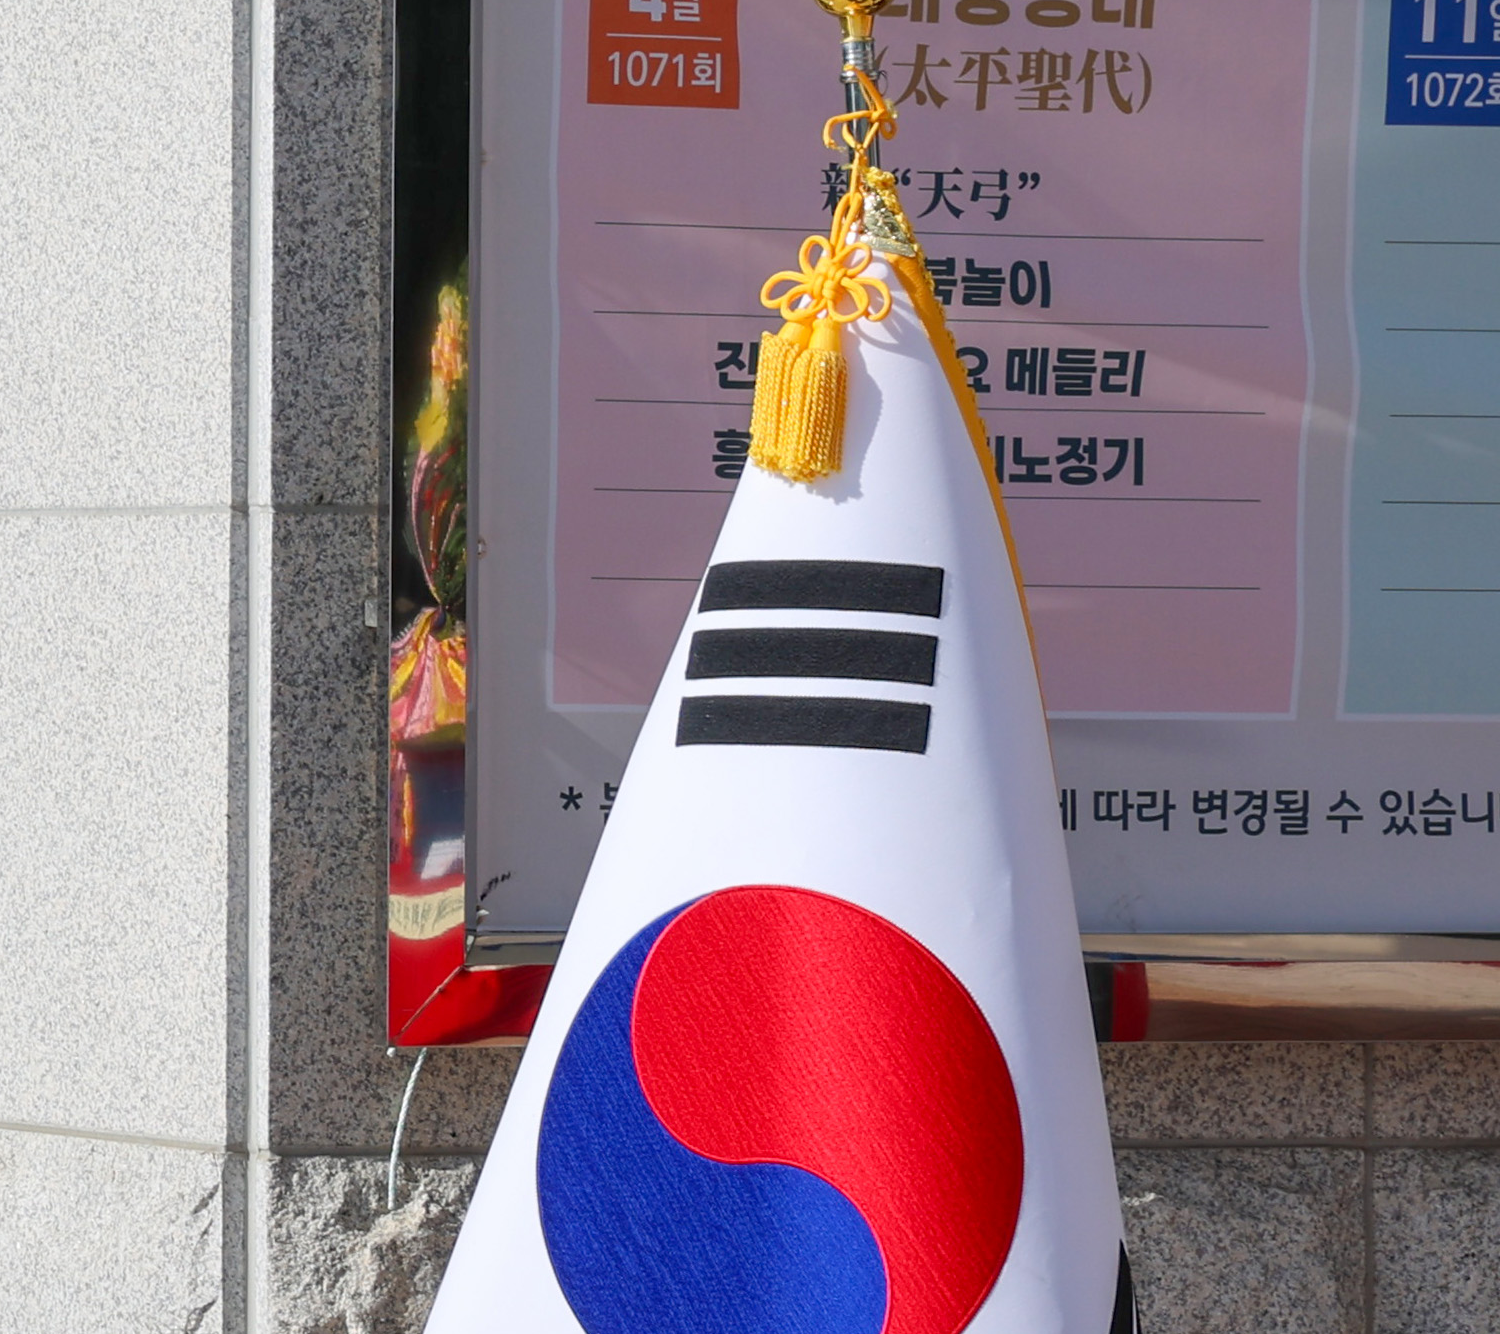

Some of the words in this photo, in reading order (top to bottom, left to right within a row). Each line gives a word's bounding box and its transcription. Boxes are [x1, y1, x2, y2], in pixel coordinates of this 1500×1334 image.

[608, 51, 722, 94] 1071회
[1005, 347, 1146, 397] 메들리
[1093, 789, 1176, 832] 따라
[1192, 789, 1310, 836] 변경될
[1326, 790, 1364, 834] 수
[1379, 788, 1496, 837] 있습니
